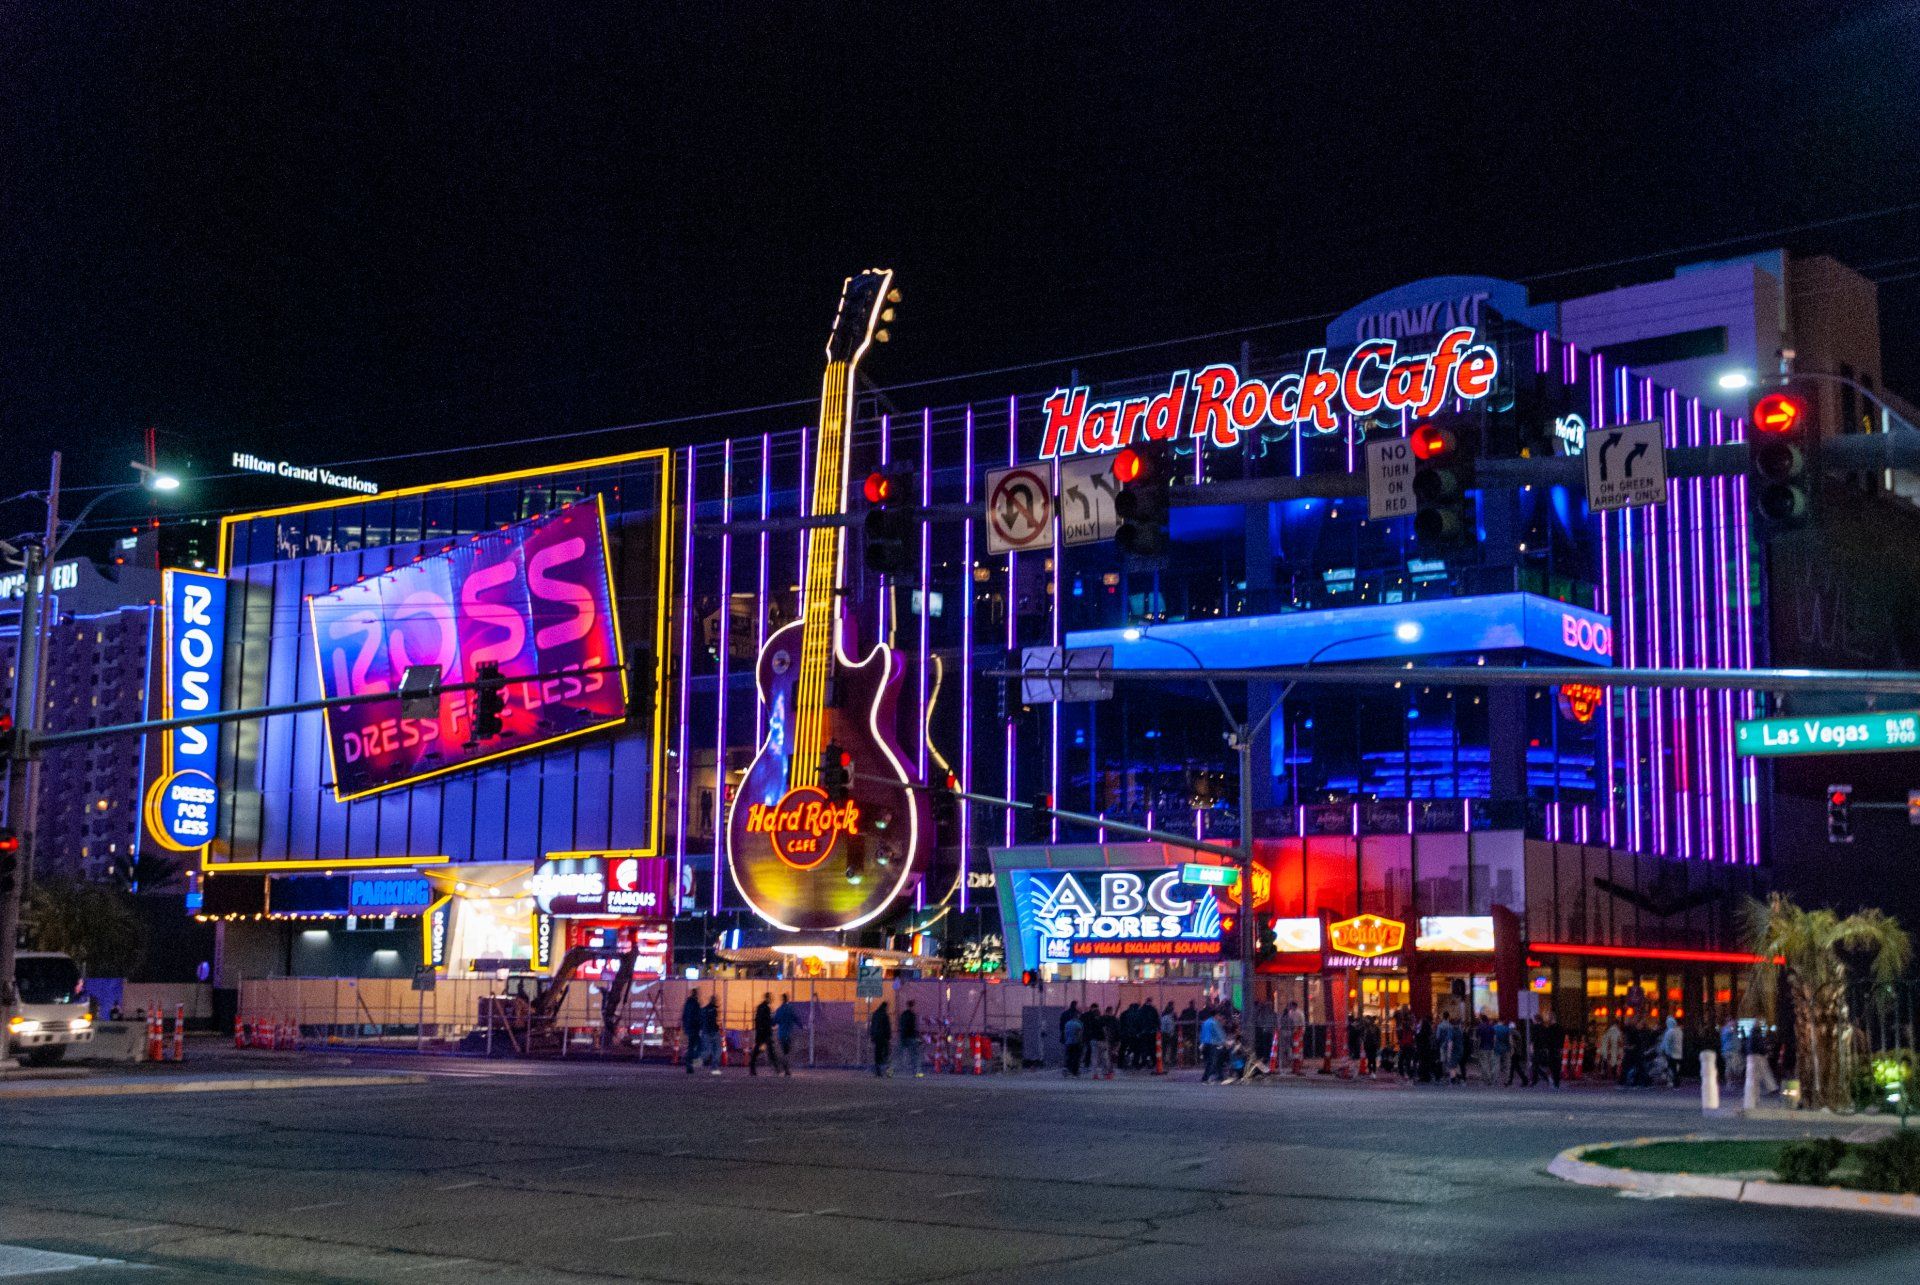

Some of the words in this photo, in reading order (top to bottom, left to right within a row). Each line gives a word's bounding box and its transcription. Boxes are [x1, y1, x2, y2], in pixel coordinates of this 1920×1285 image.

[1039, 369, 1190, 459] Hard
[1190, 347, 1341, 449] Rock
[1342, 326, 1498, 418] Cafe
[1381, 445, 1406, 461] NO
[232, 452, 275, 474] Hilton
[278, 461, 318, 483] Grand
[319, 469, 378, 494] Vacations
[1382, 464, 1409, 478] TURN
[1388, 482, 1403, 494] ON
[1600, 483, 1614, 494] ON
[1620, 478, 1654, 491] GREEN
[1385, 498, 1407, 512] RED
[1594, 493, 1629, 507] ARROW
[1635, 488, 1661, 501] ONLY
[1066, 522, 1096, 539] ONLY
[328, 536, 596, 712] ROSS
[179, 584, 214, 755] ROSS
[343, 716, 440, 763] DRESS
[522, 657, 604, 711] LESS
[1763, 723, 1800, 746] Las
[1804, 720, 1869, 748] Vegas
[171, 785, 215, 804] DRESS
[178, 803, 207, 819] FOR
[746, 802, 805, 832] Hard
[805, 799, 860, 836] Rock
[174, 819, 208, 835] LESS
[787, 839, 817, 853] CAFE
[352, 879, 429, 906] PARKING
[608, 891, 656, 906] FAMOUS
[1039, 870, 1193, 917] ABC
[1054, 915, 1183, 938] STORES
[1337, 925, 1400, 946] Denny's
[433, 911, 445, 963] ROSS
[1074, 942, 1091, 954] LAS
[1095, 942, 1122, 954] VEGAS
